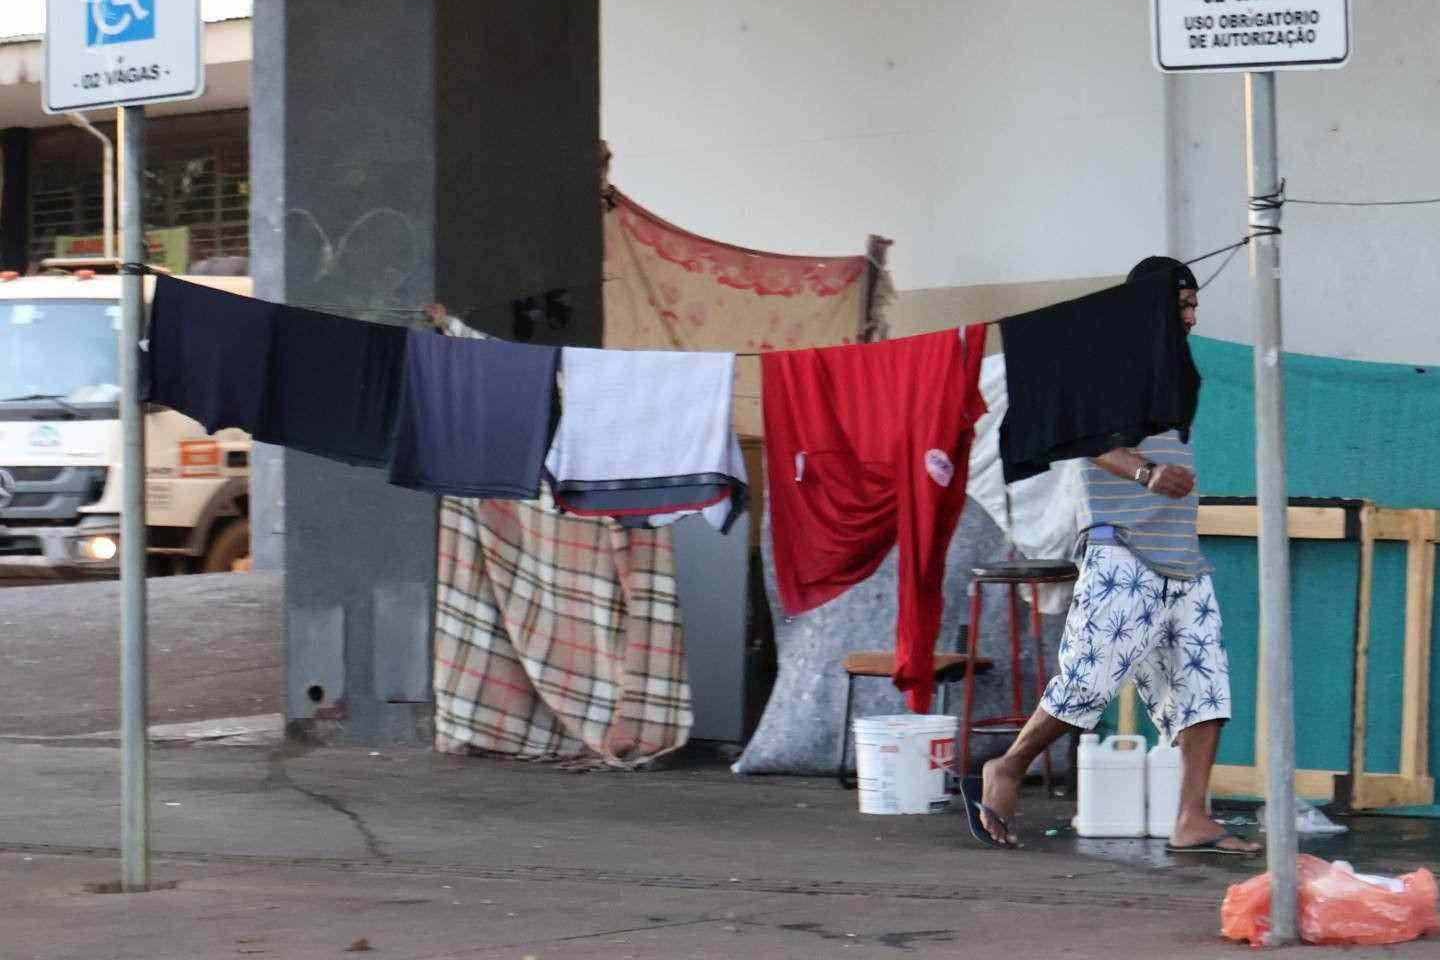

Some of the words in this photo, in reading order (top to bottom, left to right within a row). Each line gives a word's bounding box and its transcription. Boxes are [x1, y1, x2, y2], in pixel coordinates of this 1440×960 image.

[1184, 15, 1214, 31] USO
[1189, 34, 1207, 49] DE
[1212, 27, 1316, 48] AUTORIZAÇÃO
